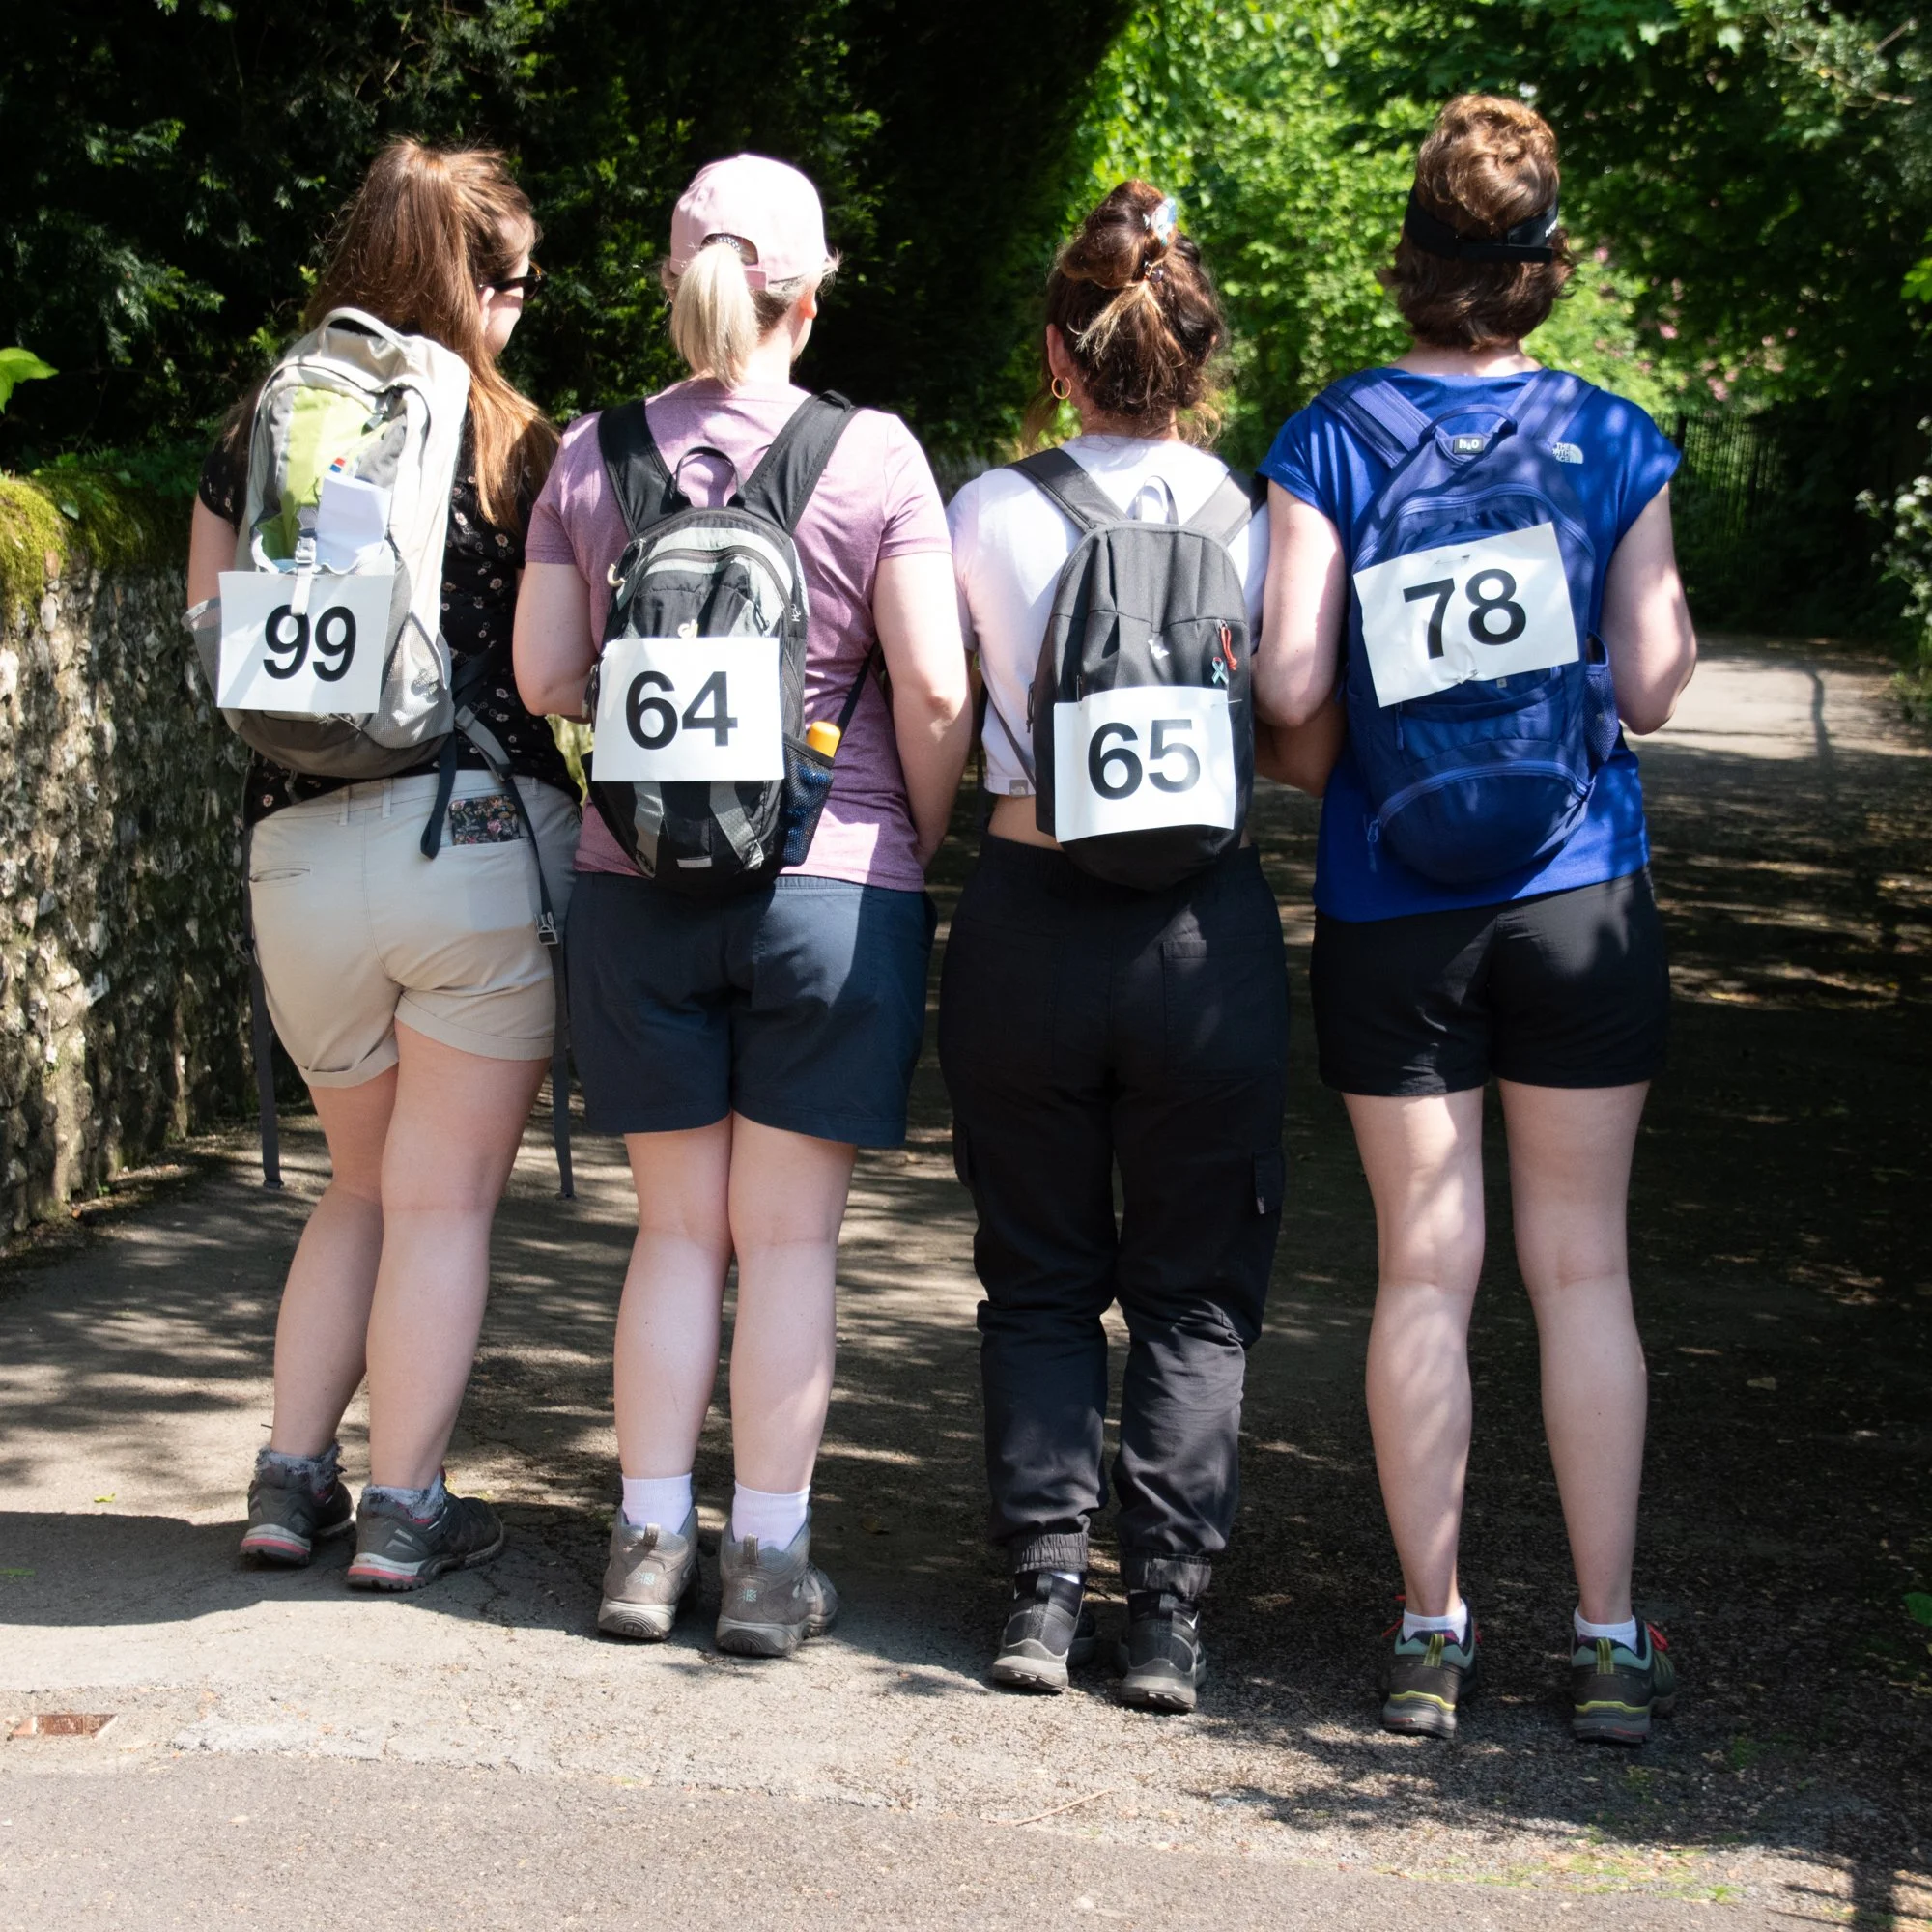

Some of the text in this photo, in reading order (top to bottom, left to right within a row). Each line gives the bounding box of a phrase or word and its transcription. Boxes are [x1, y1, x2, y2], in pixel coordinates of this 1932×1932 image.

[264, 604, 356, 682] 99
[1404, 568, 1526, 659] 78
[626, 671, 738, 750] 64
[1088, 719, 1201, 800] 65
